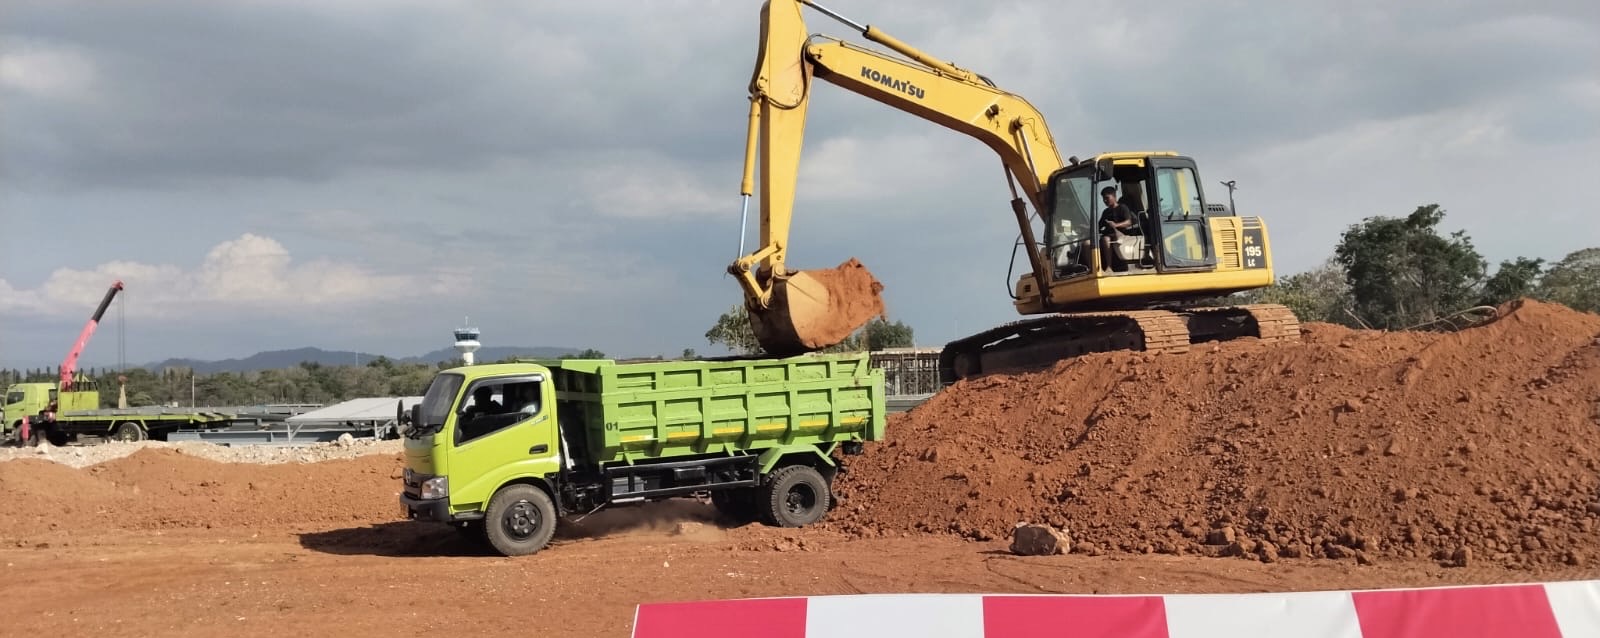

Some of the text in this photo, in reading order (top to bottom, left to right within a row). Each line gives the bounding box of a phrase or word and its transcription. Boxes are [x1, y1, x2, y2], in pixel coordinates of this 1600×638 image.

[861, 66, 925, 99] KOMATSU
[1245, 245, 1262, 257] 195
[1247, 258, 1256, 267] LC
[605, 421, 618, 431] 01
